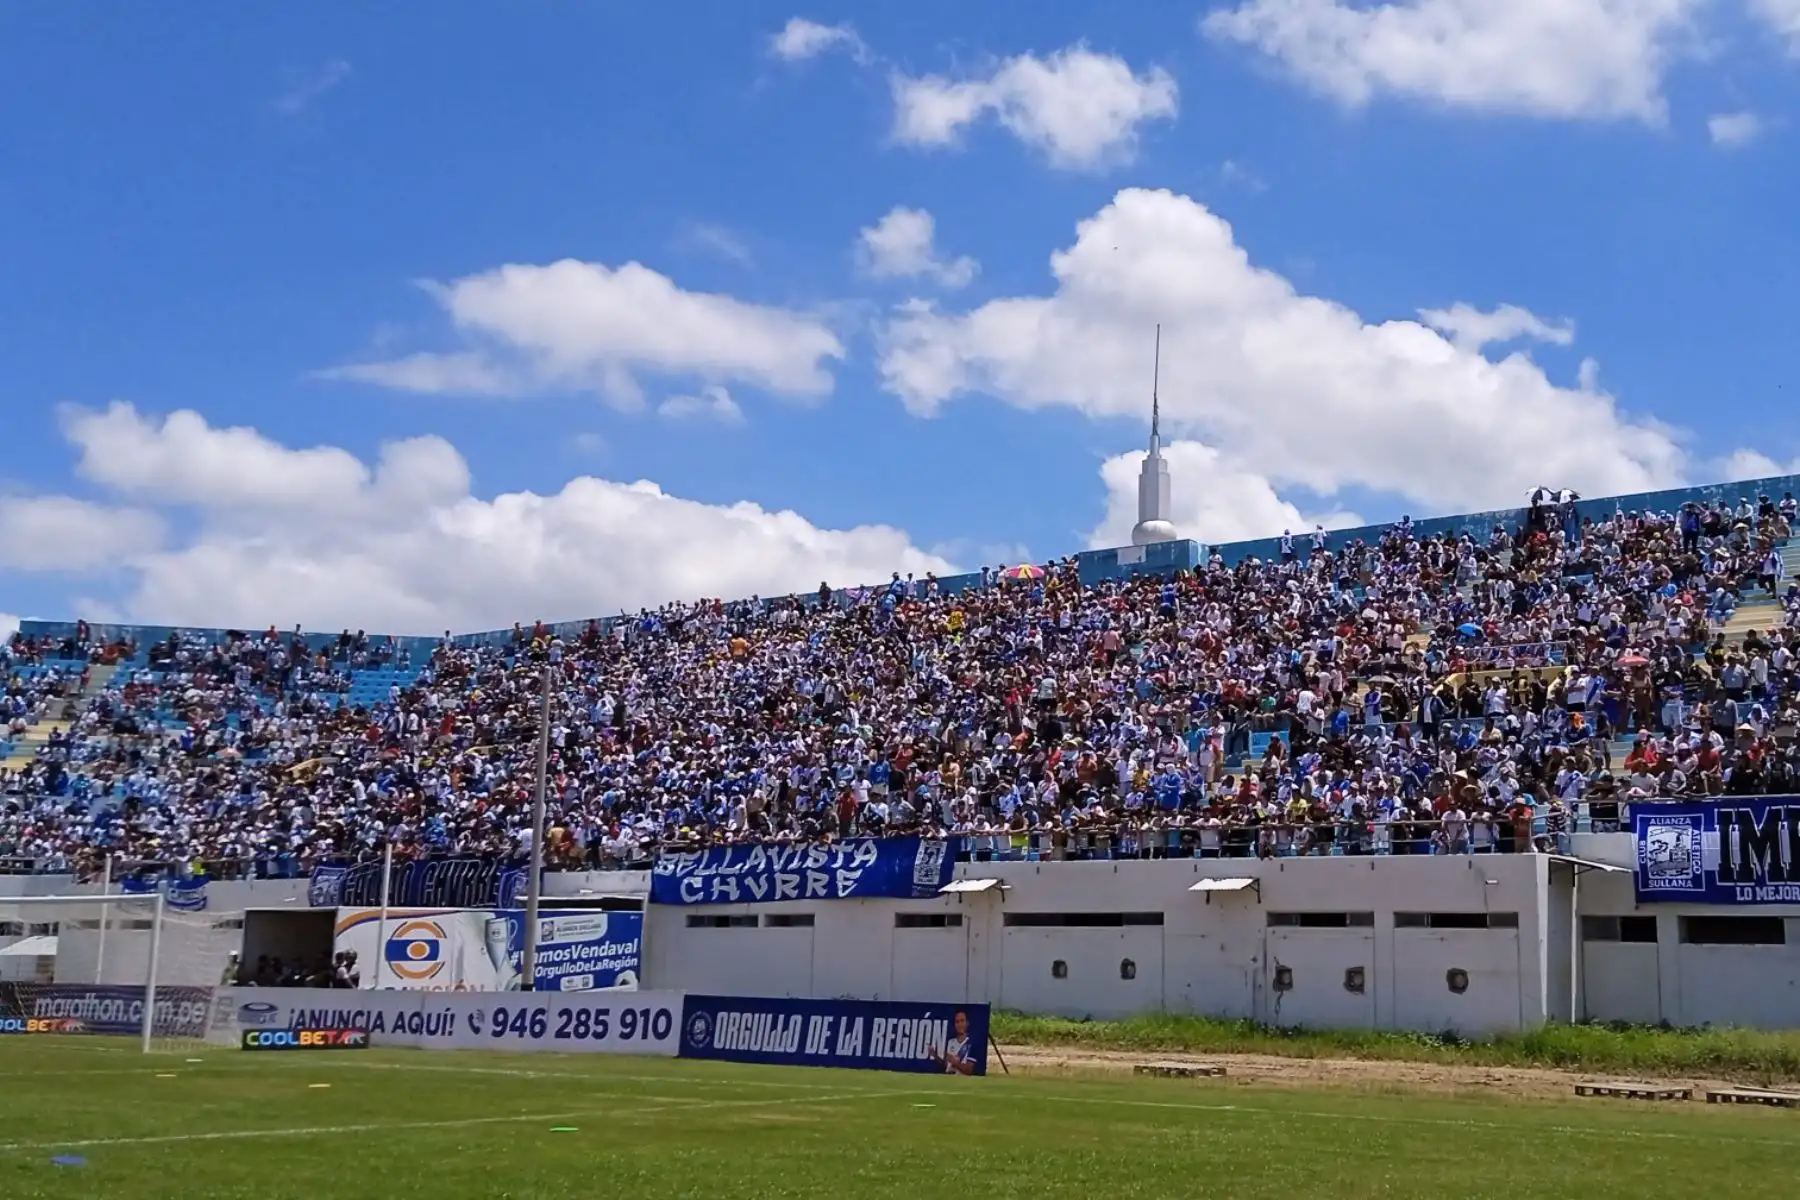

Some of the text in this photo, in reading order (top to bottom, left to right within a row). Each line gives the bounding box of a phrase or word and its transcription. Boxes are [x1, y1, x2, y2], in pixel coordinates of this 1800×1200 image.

[1650, 817, 1691, 825] ALIANZA
[654, 840, 878, 877] BELLAVISTA
[1648, 879, 1693, 888] SULLANA
[1736, 886, 1800, 900] LO MEJOR
[34, 992, 206, 1029] marathon.cm.pe
[288, 1009, 385, 1033] ¡ANUNCIA
[391, 1008, 456, 1036] AQUÍ!
[491, 1007, 547, 1039] 946
[554, 1008, 610, 1040] 285
[619, 1008, 673, 1041] 910
[713, 1011, 801, 1051] ORGULLO
[805, 1015, 834, 1055] DE
[835, 1016, 863, 1057] LA
[868, 1012, 948, 1061] REGIÓN
